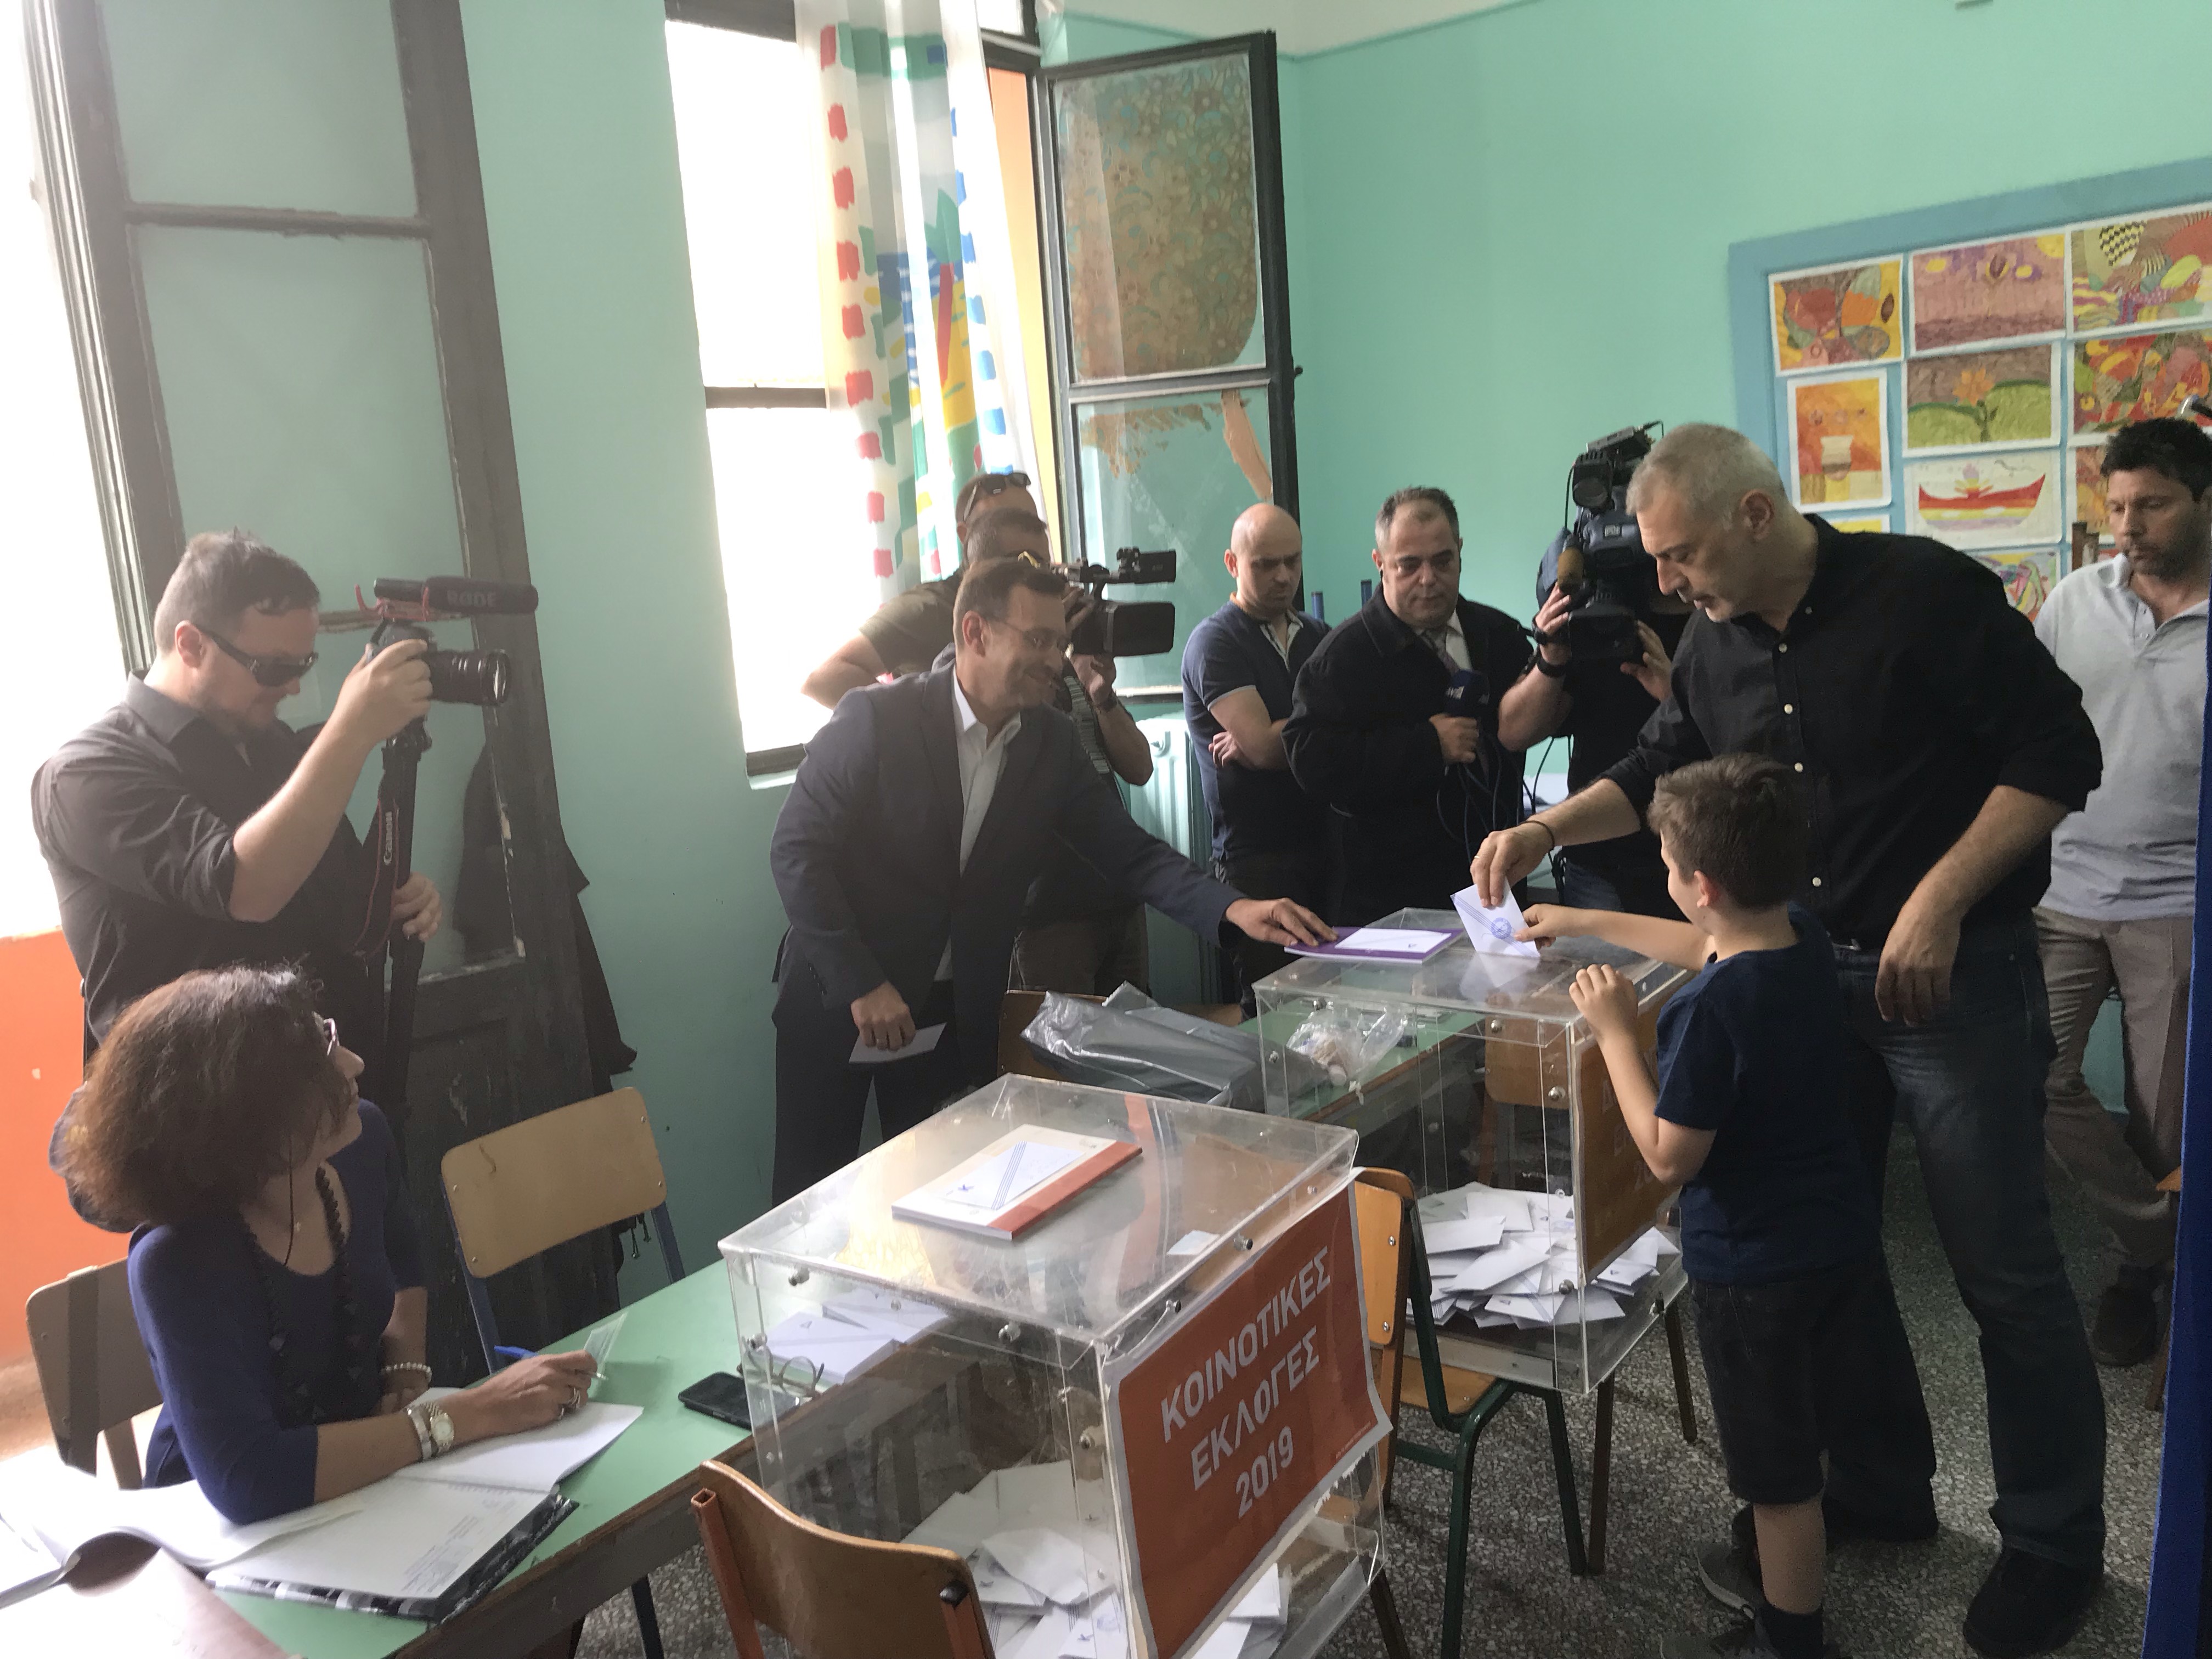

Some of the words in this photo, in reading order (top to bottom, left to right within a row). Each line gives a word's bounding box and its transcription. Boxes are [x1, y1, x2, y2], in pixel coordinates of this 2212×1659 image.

[383, 811, 393, 865] Canon
[1161, 1245, 1331, 1443] ΚΟΙΝΟΤΙΚΕΣ
[1190, 1325, 1319, 1491] ΕΚΛΟΓΕΣ
[1235, 1426, 1294, 1519] 2019
